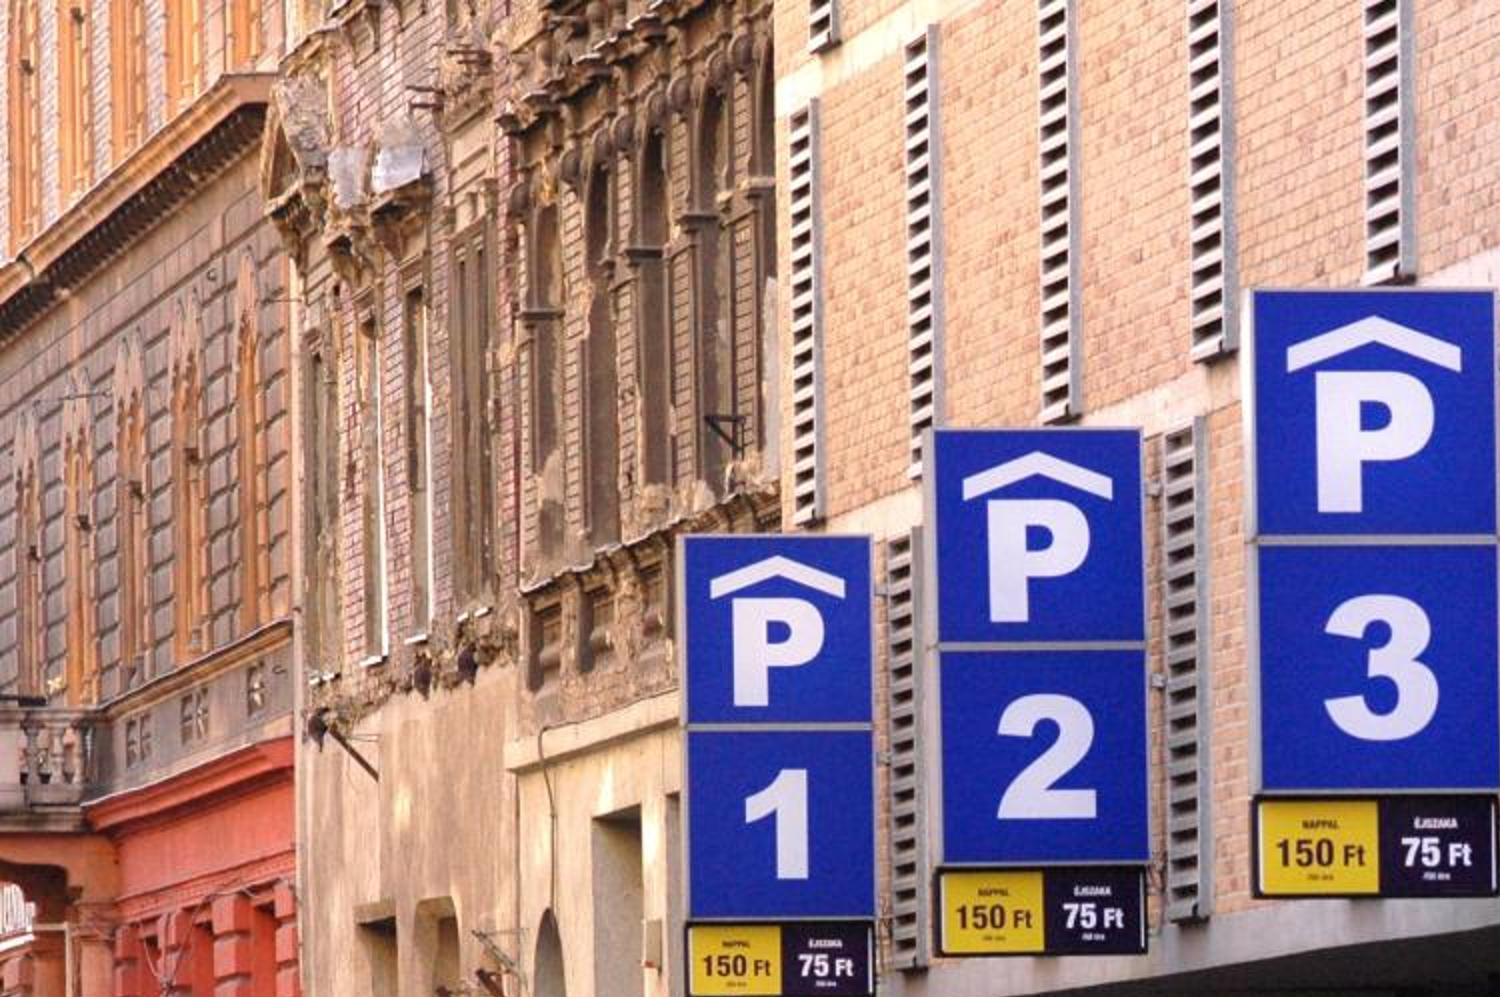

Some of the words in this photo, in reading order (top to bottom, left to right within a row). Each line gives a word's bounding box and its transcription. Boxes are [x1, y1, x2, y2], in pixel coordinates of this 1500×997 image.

[1315, 371, 1435, 513] P
[987, 498, 1090, 623] P
[731, 597, 825, 707] P
[1323, 594, 1439, 741] 3
[997, 693, 1097, 819] 2
[744, 769, 809, 880] 1
[1276, 838, 1334, 868] 150
[1343, 844, 1366, 868] Ft
[1401, 836, 1441, 868] 75
[1448, 842, 1473, 868] Ft
[955, 903, 1006, 930] 150
[1013, 909, 1033, 930] Ft
[1062, 902, 1098, 930] 75
[1103, 907, 1125, 930] Ft
[702, 954, 747, 977] 150
[753, 959, 772, 977] Ft
[798, 953, 829, 977] 75
[835, 957, 855, 977] Ft
